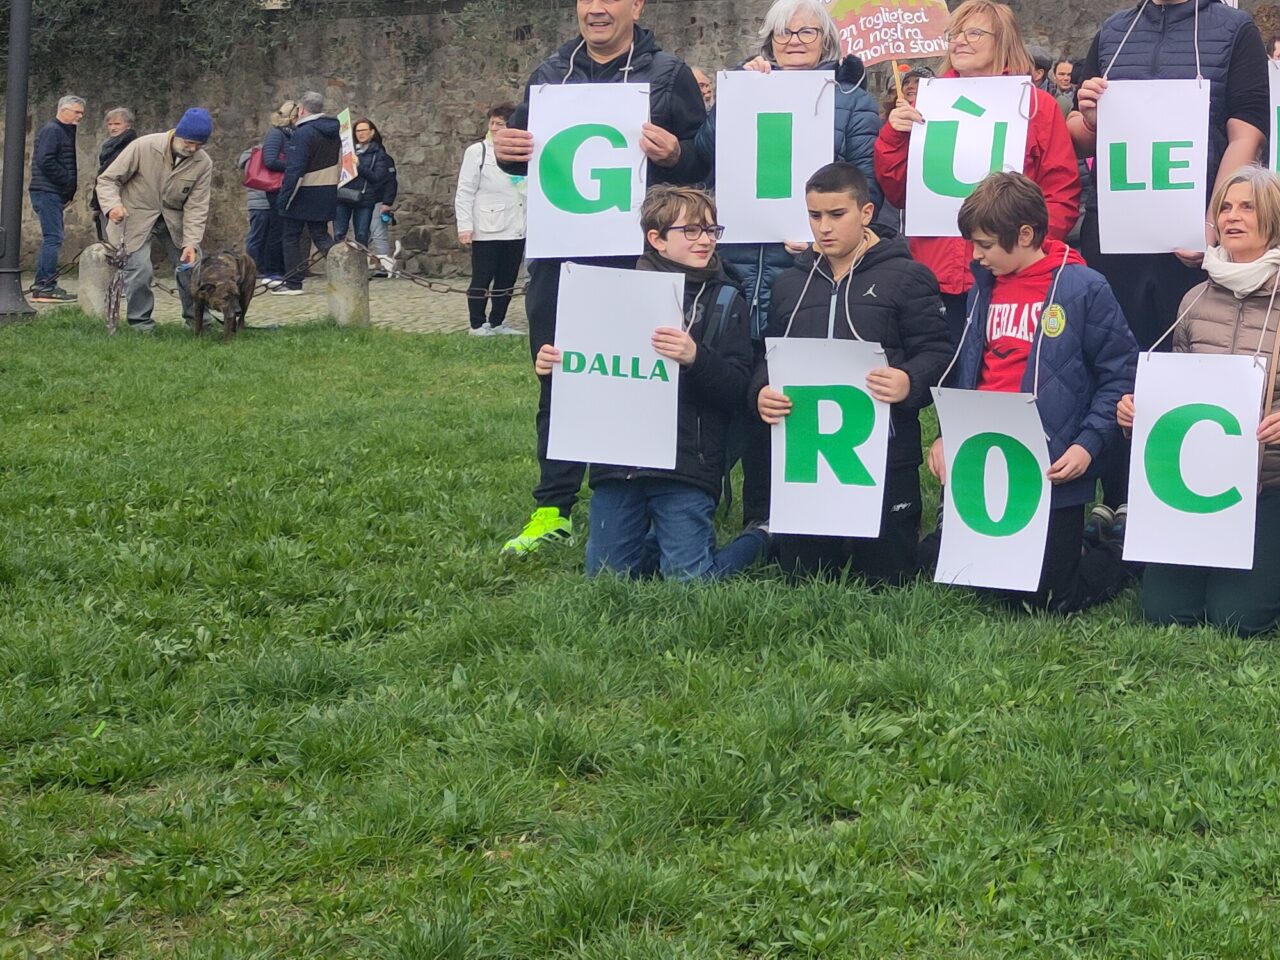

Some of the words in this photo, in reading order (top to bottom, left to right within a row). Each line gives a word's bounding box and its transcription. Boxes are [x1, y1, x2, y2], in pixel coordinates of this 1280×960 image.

[858, 6, 930, 31] toglieteci
[846, 37, 864, 54] la
[869, 22, 924, 43] nostra
[539, 124, 632, 214] G
[756, 112, 793, 199] I
[922, 95, 1007, 199] Ù
[1109, 141, 1195, 191] LE
[562, 351, 669, 382] DALLA
[783, 384, 877, 487] R
[951, 431, 1043, 537] O
[1144, 403, 1242, 514] C
